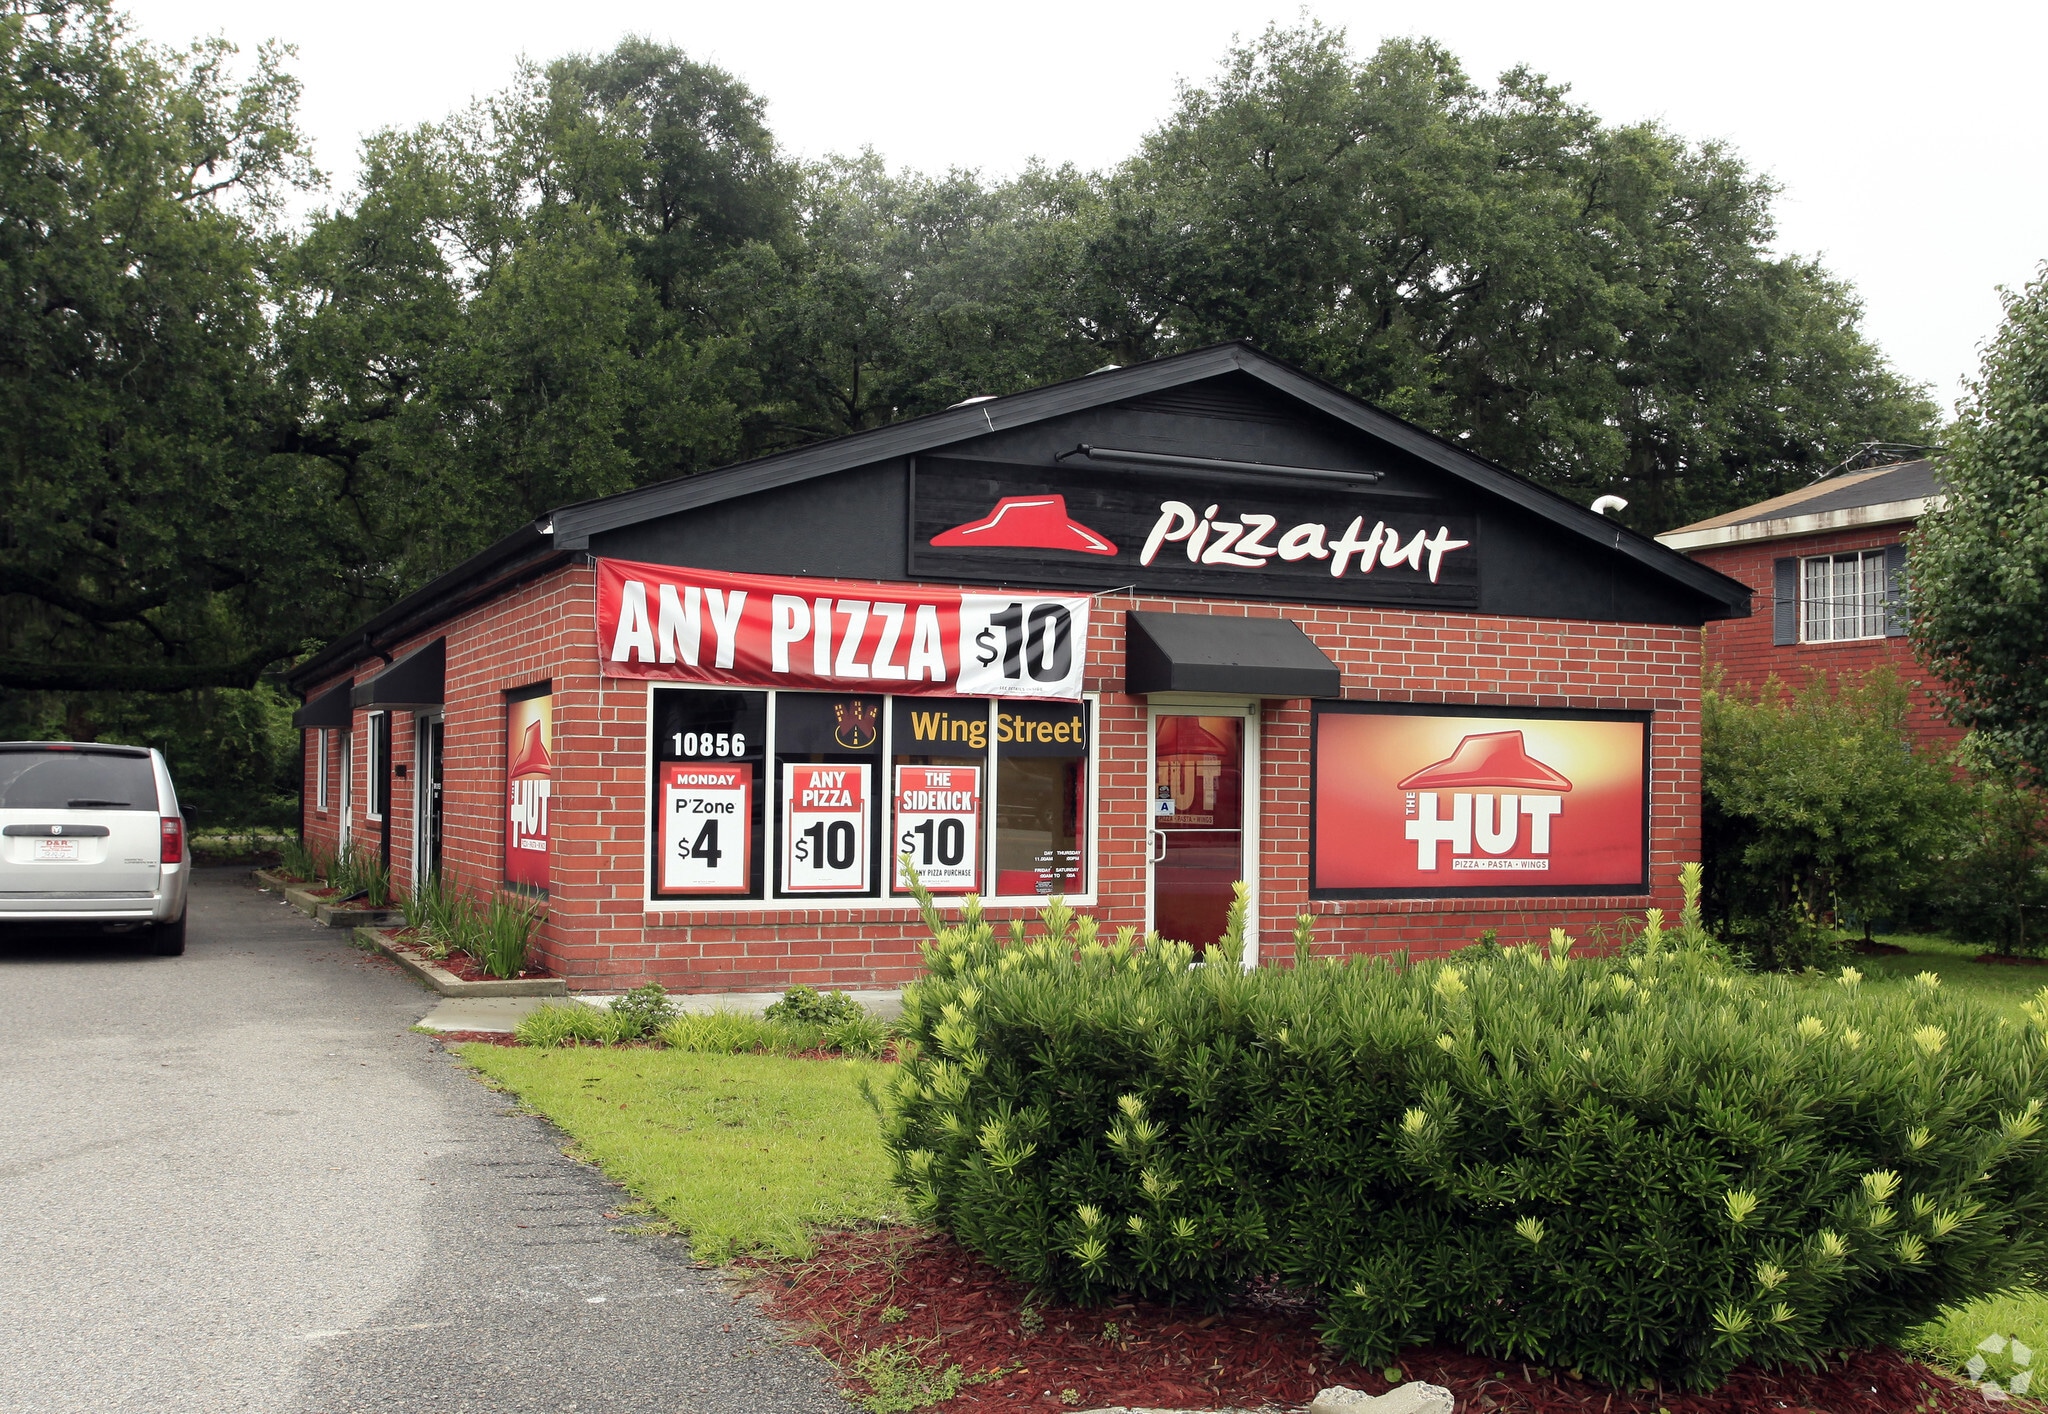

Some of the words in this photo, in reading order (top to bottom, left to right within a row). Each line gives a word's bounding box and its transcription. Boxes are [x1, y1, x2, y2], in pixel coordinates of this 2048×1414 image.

[1139, 500, 1329, 568] Pizza
[1328, 515, 1470, 584] Hut
[611, 579, 748, 669] ANY
[772, 593, 946, 682] PIZZA
[975, 602, 1073, 683] $10
[911, 711, 987, 749] Wing
[997, 713, 1082, 744] Street
[672, 733, 746, 757] 10856
[677, 774, 736, 786] MONDAY
[809, 771, 847, 789] ANY
[925, 772, 951, 787] THE
[676, 799, 735, 814] P'Zone
[802, 789, 853, 807] PIZZA
[903, 790, 972, 811] SIDEKICK
[1161, 802, 1169, 811] A
[1406, 792, 1416, 815] THE
[510, 779, 551, 848] HUT
[901, 818, 965, 867] $10
[1405, 792, 1562, 870] HUT
[678, 819, 722, 868] $4
[795, 820, 856, 870] $10
[927, 869, 942, 877] PIZZA
[944, 869, 971, 877] PURCHASE
[1454, 860, 1480, 868] PIZZA
[1521, 861, 1547, 869] WINGS
